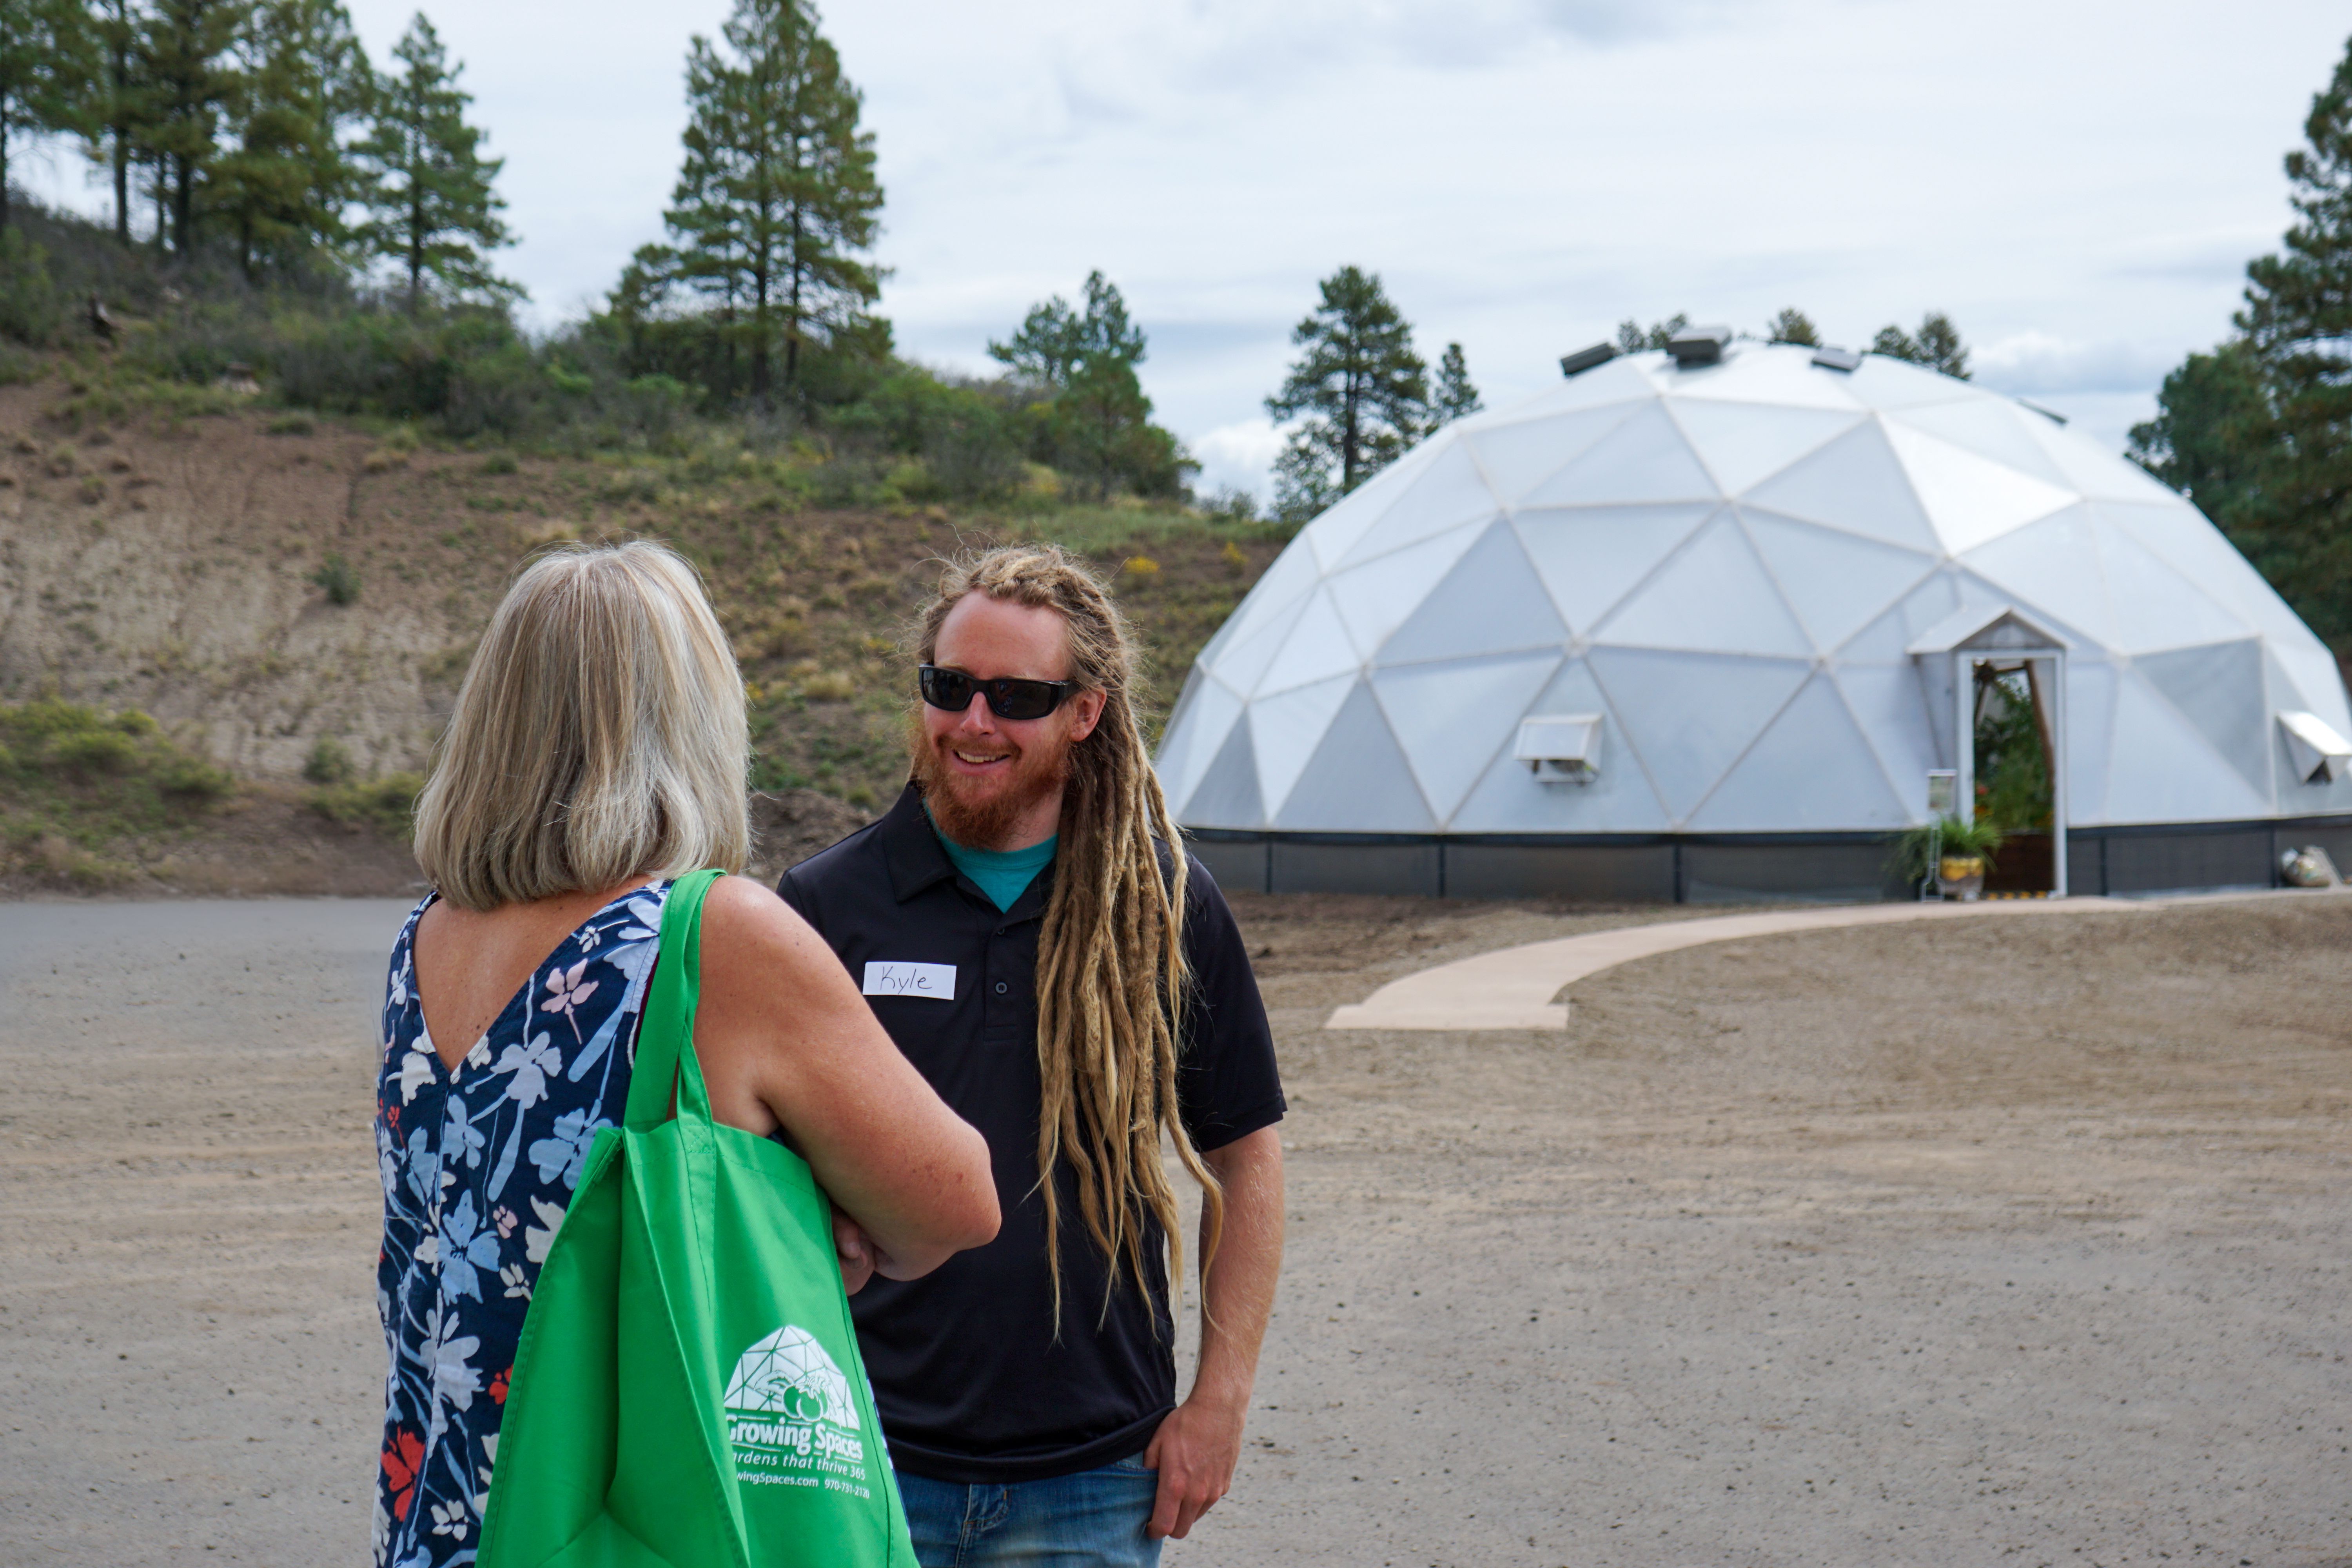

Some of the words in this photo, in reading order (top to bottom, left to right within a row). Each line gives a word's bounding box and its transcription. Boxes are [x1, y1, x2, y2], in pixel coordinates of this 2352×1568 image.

[880, 965, 933, 995] Kyle
[726, 1414, 812, 1455] Growing
[814, 1423, 863, 1460] Spaces
[783, 1453, 813, 1469] that
[817, 1458, 848, 1475] thrive
[850, 1465, 866, 1481] 365
[824, 1478, 870, 1499] 970-731-2120
